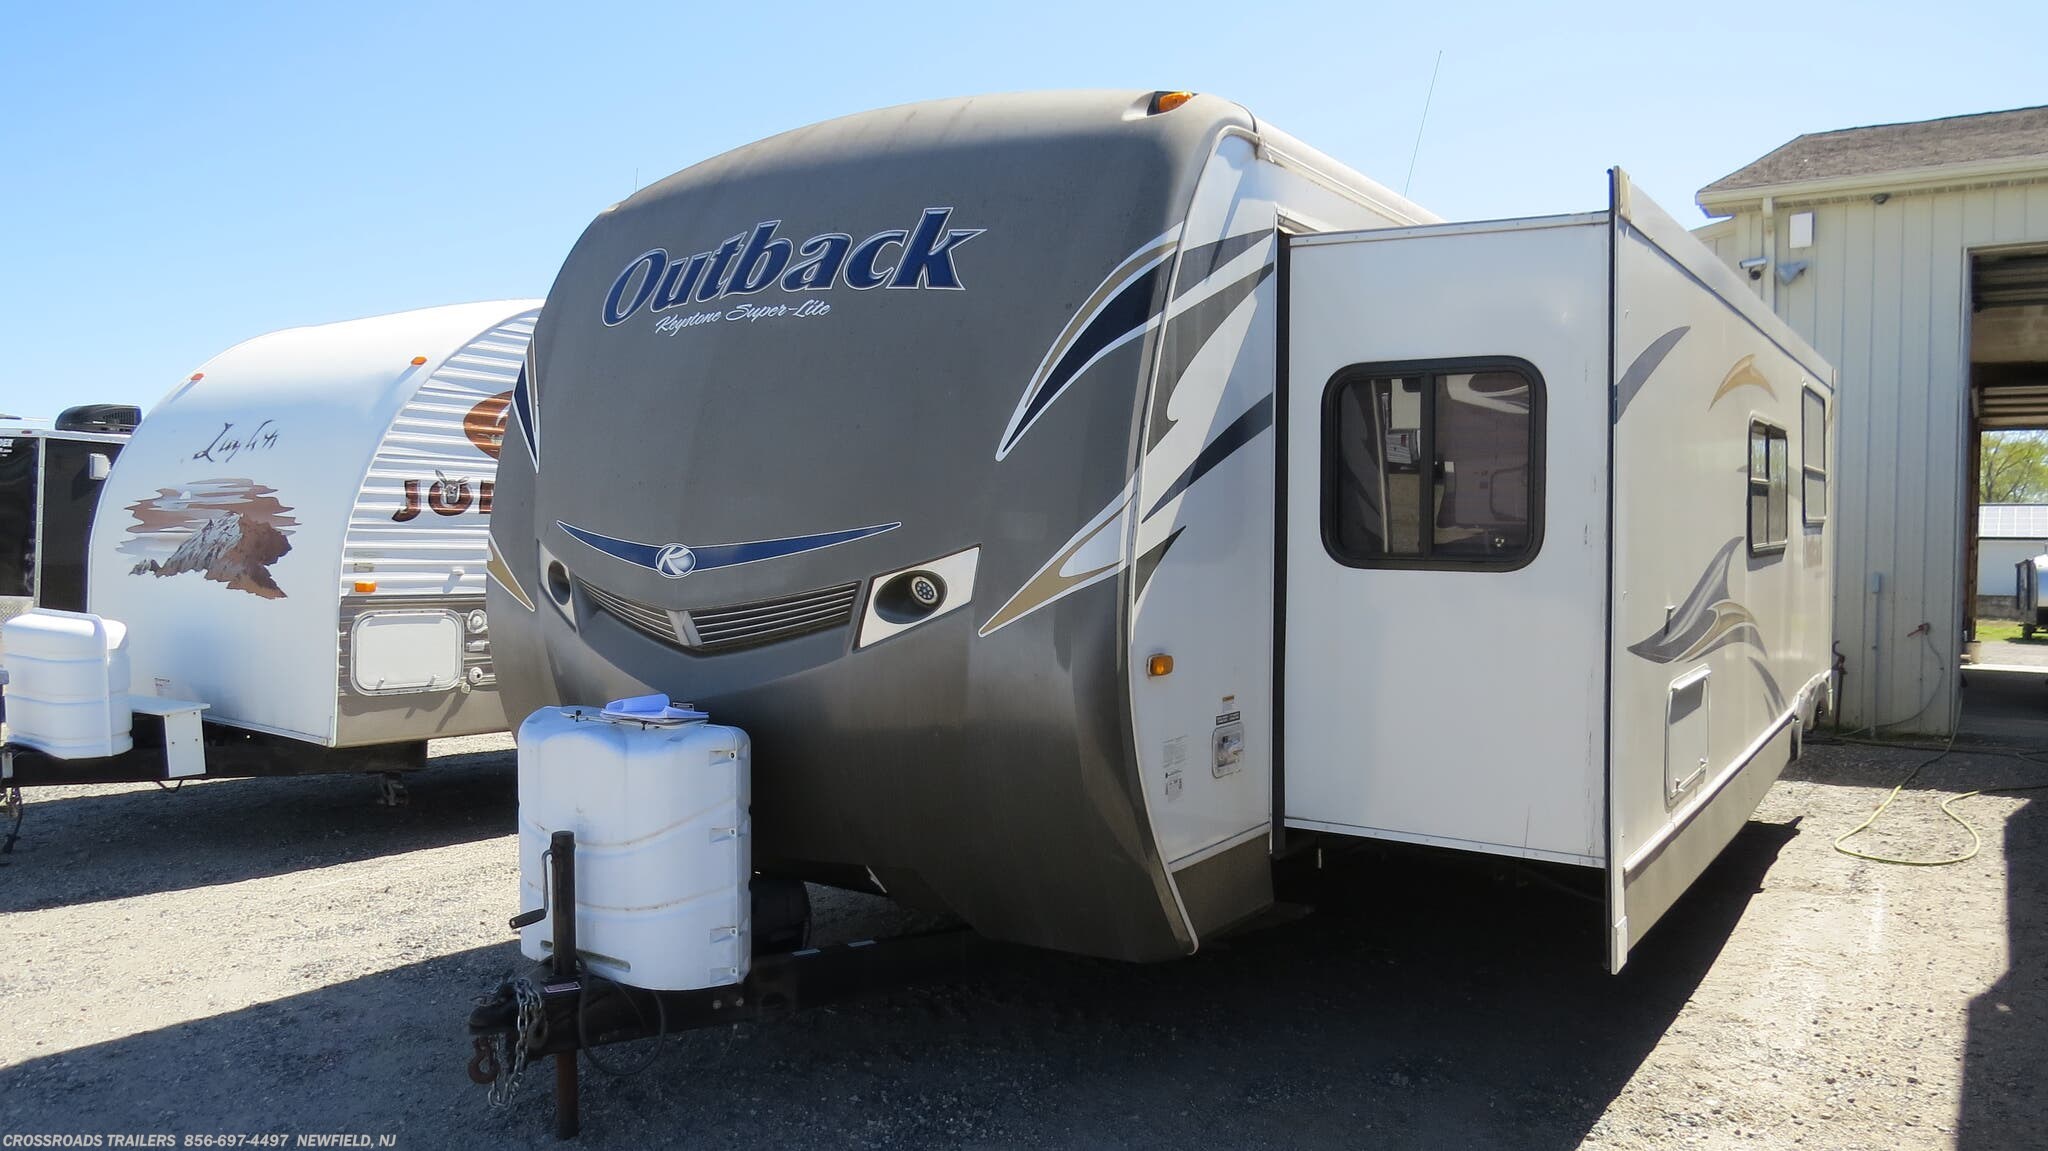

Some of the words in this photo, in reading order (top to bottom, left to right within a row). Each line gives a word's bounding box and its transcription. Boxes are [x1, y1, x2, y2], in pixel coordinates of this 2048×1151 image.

[602, 207, 987, 328] Outback
[655, 311, 722, 337] Keystone
[725, 299, 832, 323] Super-Lite
